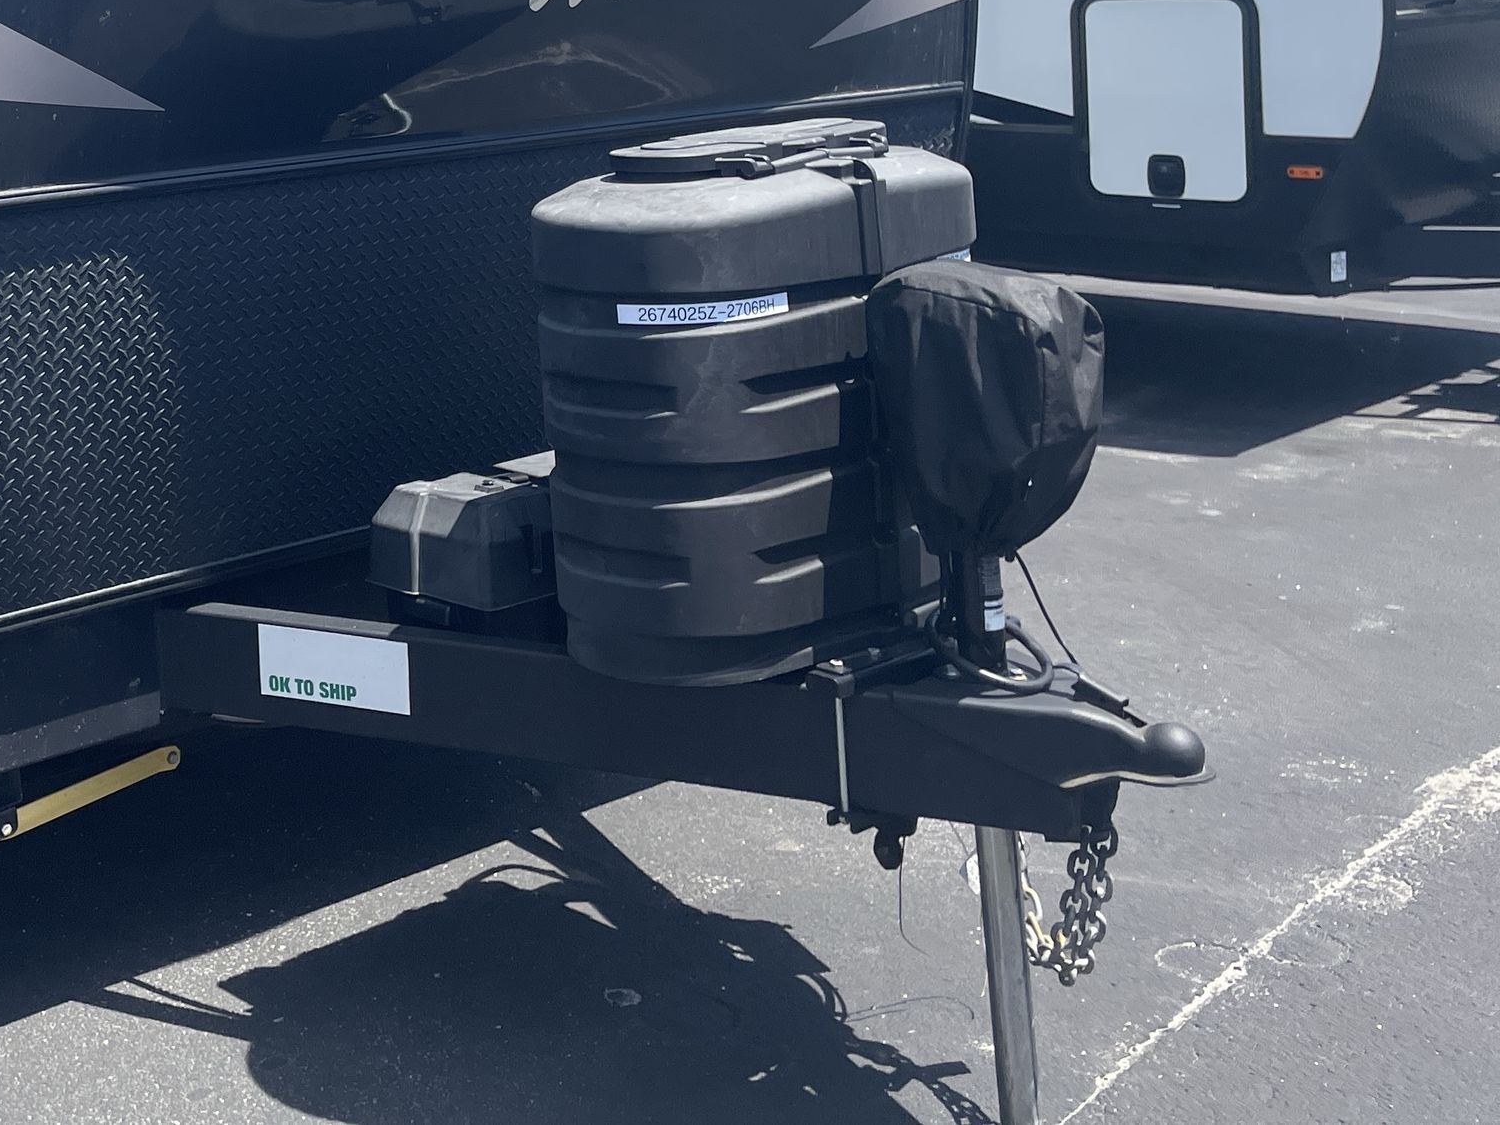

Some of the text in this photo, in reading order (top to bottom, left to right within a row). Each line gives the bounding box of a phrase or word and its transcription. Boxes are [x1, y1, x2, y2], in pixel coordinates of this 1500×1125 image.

[637, 298, 776, 322] 2674025Z-2706BH
[268, 675, 357, 702] OK TO SHIP
